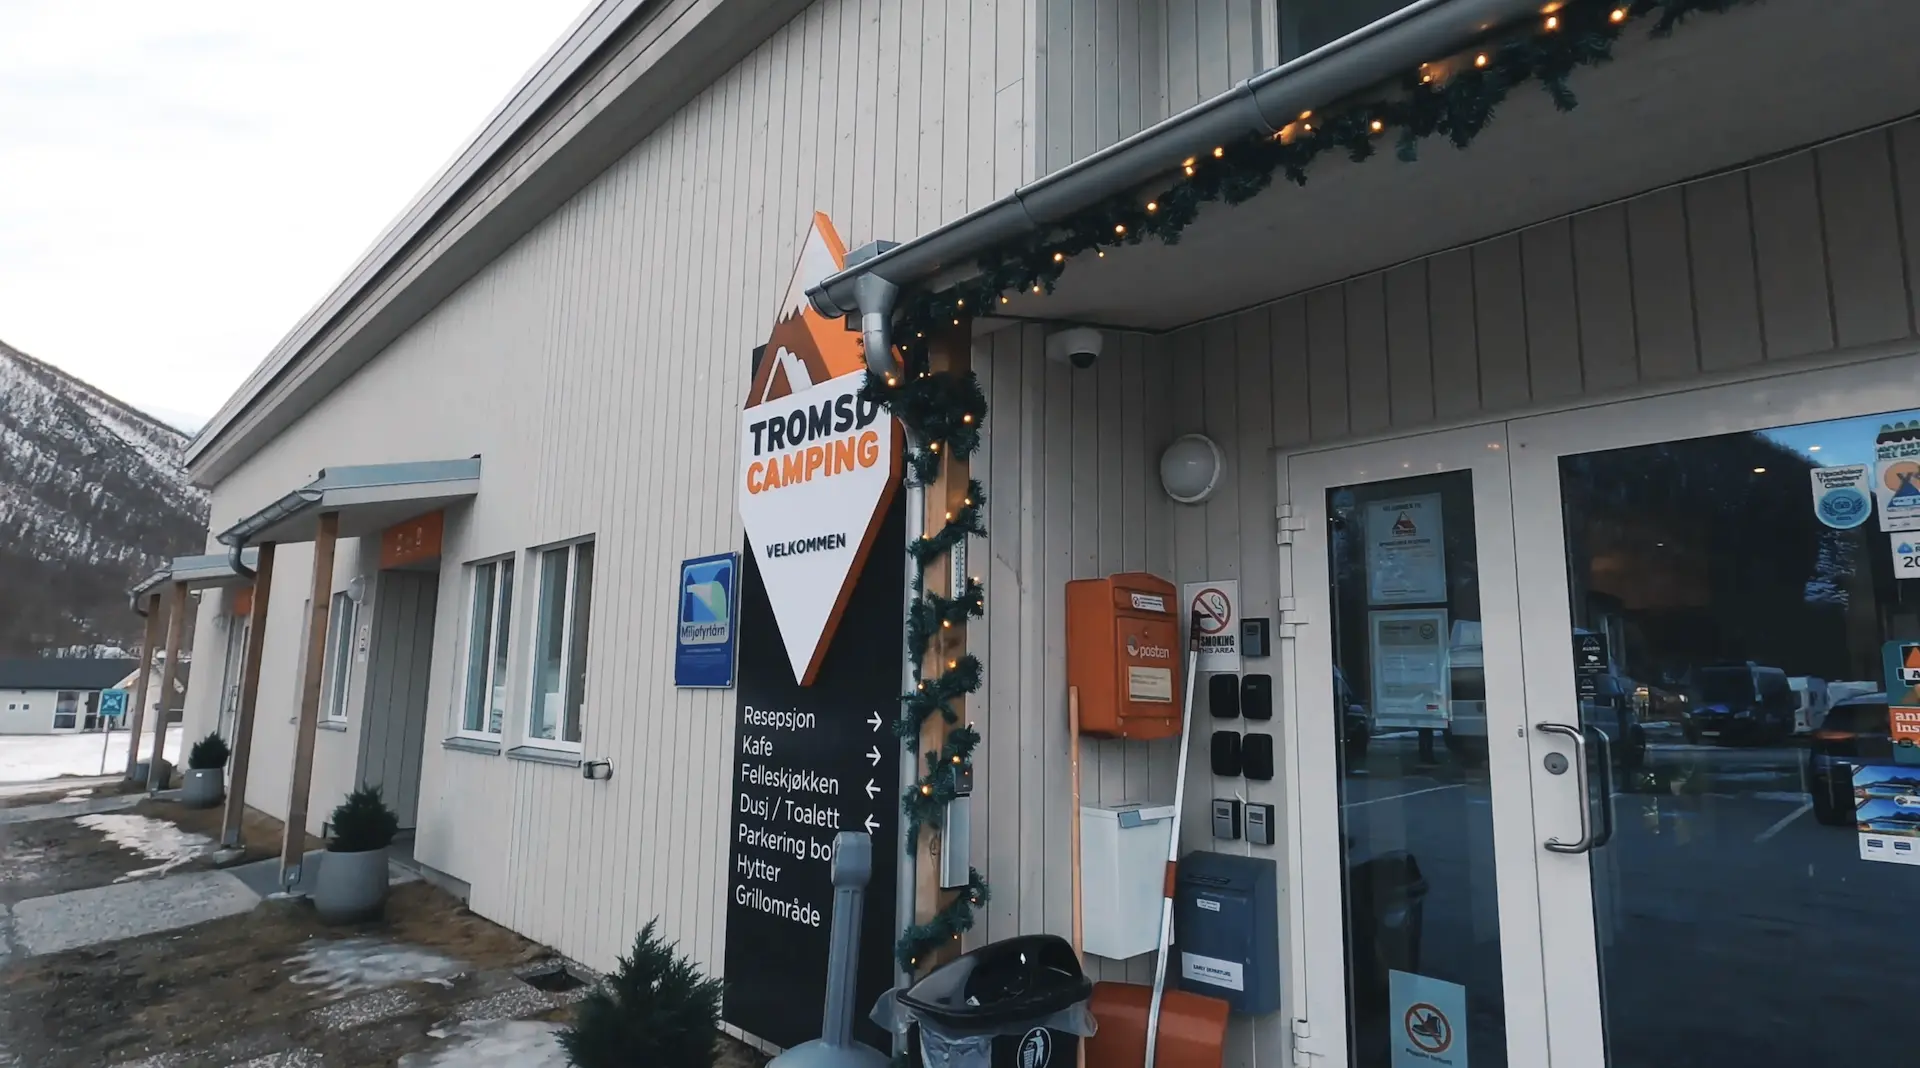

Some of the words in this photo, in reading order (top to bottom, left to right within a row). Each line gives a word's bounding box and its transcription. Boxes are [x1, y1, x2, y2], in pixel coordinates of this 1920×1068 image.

[750, 392, 880, 456] TROMSØ
[747, 430, 879, 495] CAMPING
[766, 533, 847, 558] VELKOMMEN
[1140, 645, 1170, 659] posten
[1201, 635, 1235, 646] SMOKING
[744, 706, 816, 731] Resepsjon
[742, 735, 773, 757] Kafe
[741, 763, 839, 795] Felleskjøkken
[739, 793, 770, 821] Dusj
[771, 797, 782, 821] /
[785, 800, 840, 829] Toalett
[738, 824, 806, 861] Parkering
[737, 853, 781, 883] Hytter
[735, 884, 821, 928] Grillområde
